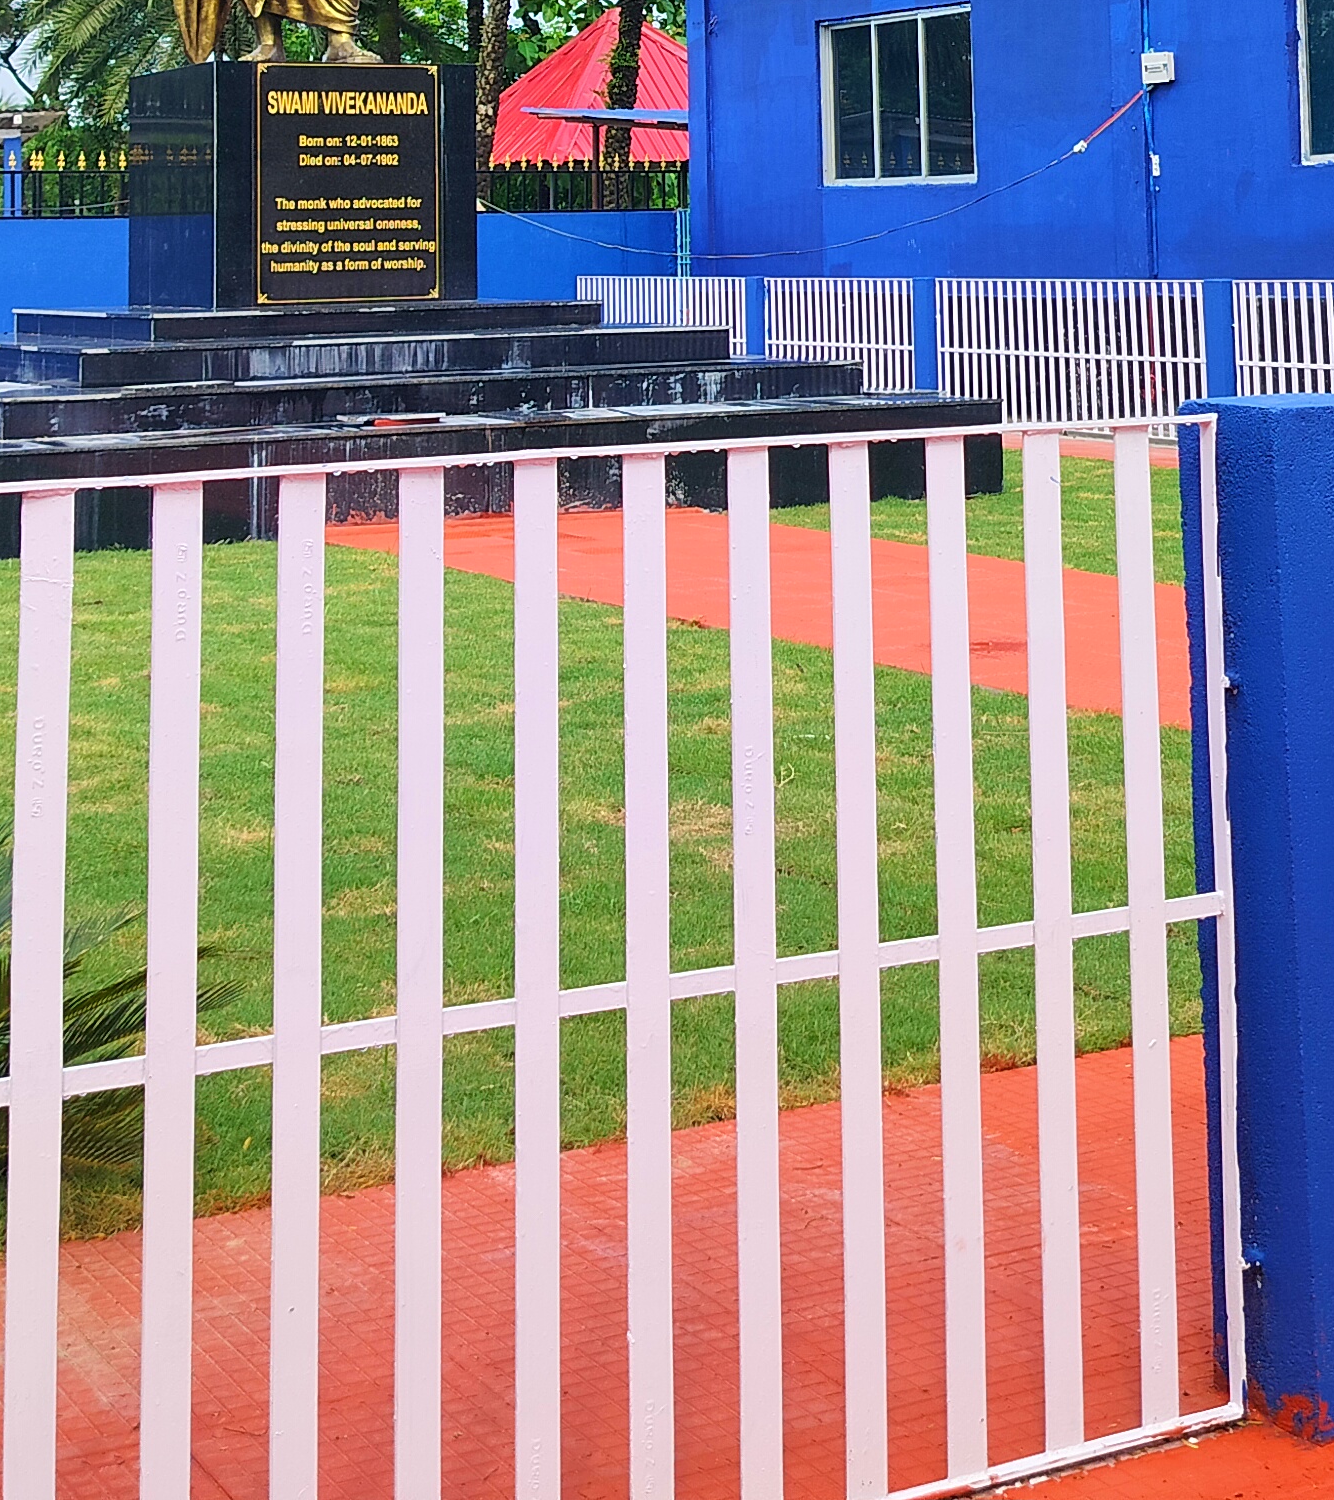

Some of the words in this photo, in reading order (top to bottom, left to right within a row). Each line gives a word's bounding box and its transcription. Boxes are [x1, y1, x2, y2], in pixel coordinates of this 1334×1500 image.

[268, 91, 319, 114] SWAMI
[322, 92, 428, 115] VIVEKANANDA
[299, 135, 324, 146] Born
[326, 137, 343, 146] on:
[346, 135, 398, 146] 12-01-1863
[300, 154, 322, 166] Died
[325, 156, 341, 166] on:
[344, 154, 398, 165] 04-07-1902
[275, 198, 295, 209] The
[298, 198, 327, 209] monk
[329, 198, 350, 208] who
[353, 198, 405, 208] advocated
[407, 198, 421, 207] for
[277, 220, 325, 233] stressing
[327, 219, 373, 230] universal
[376, 219, 422, 231] oneness,
[261, 243, 278, 253] the
[281, 242, 319, 254] divinity
[321, 241, 332, 252] of
[334, 241, 350, 252] the
[353, 240, 375, 251] soul
[377, 240, 396, 251] and
[398, 240, 435, 252] serving
[271, 261, 319, 273] humanity
[321, 262, 333, 271] as
[336, 262, 342, 270] a
[345, 259, 369, 270] form
[371, 260, 381, 269] of
[384, 258, 426, 271] worship.
